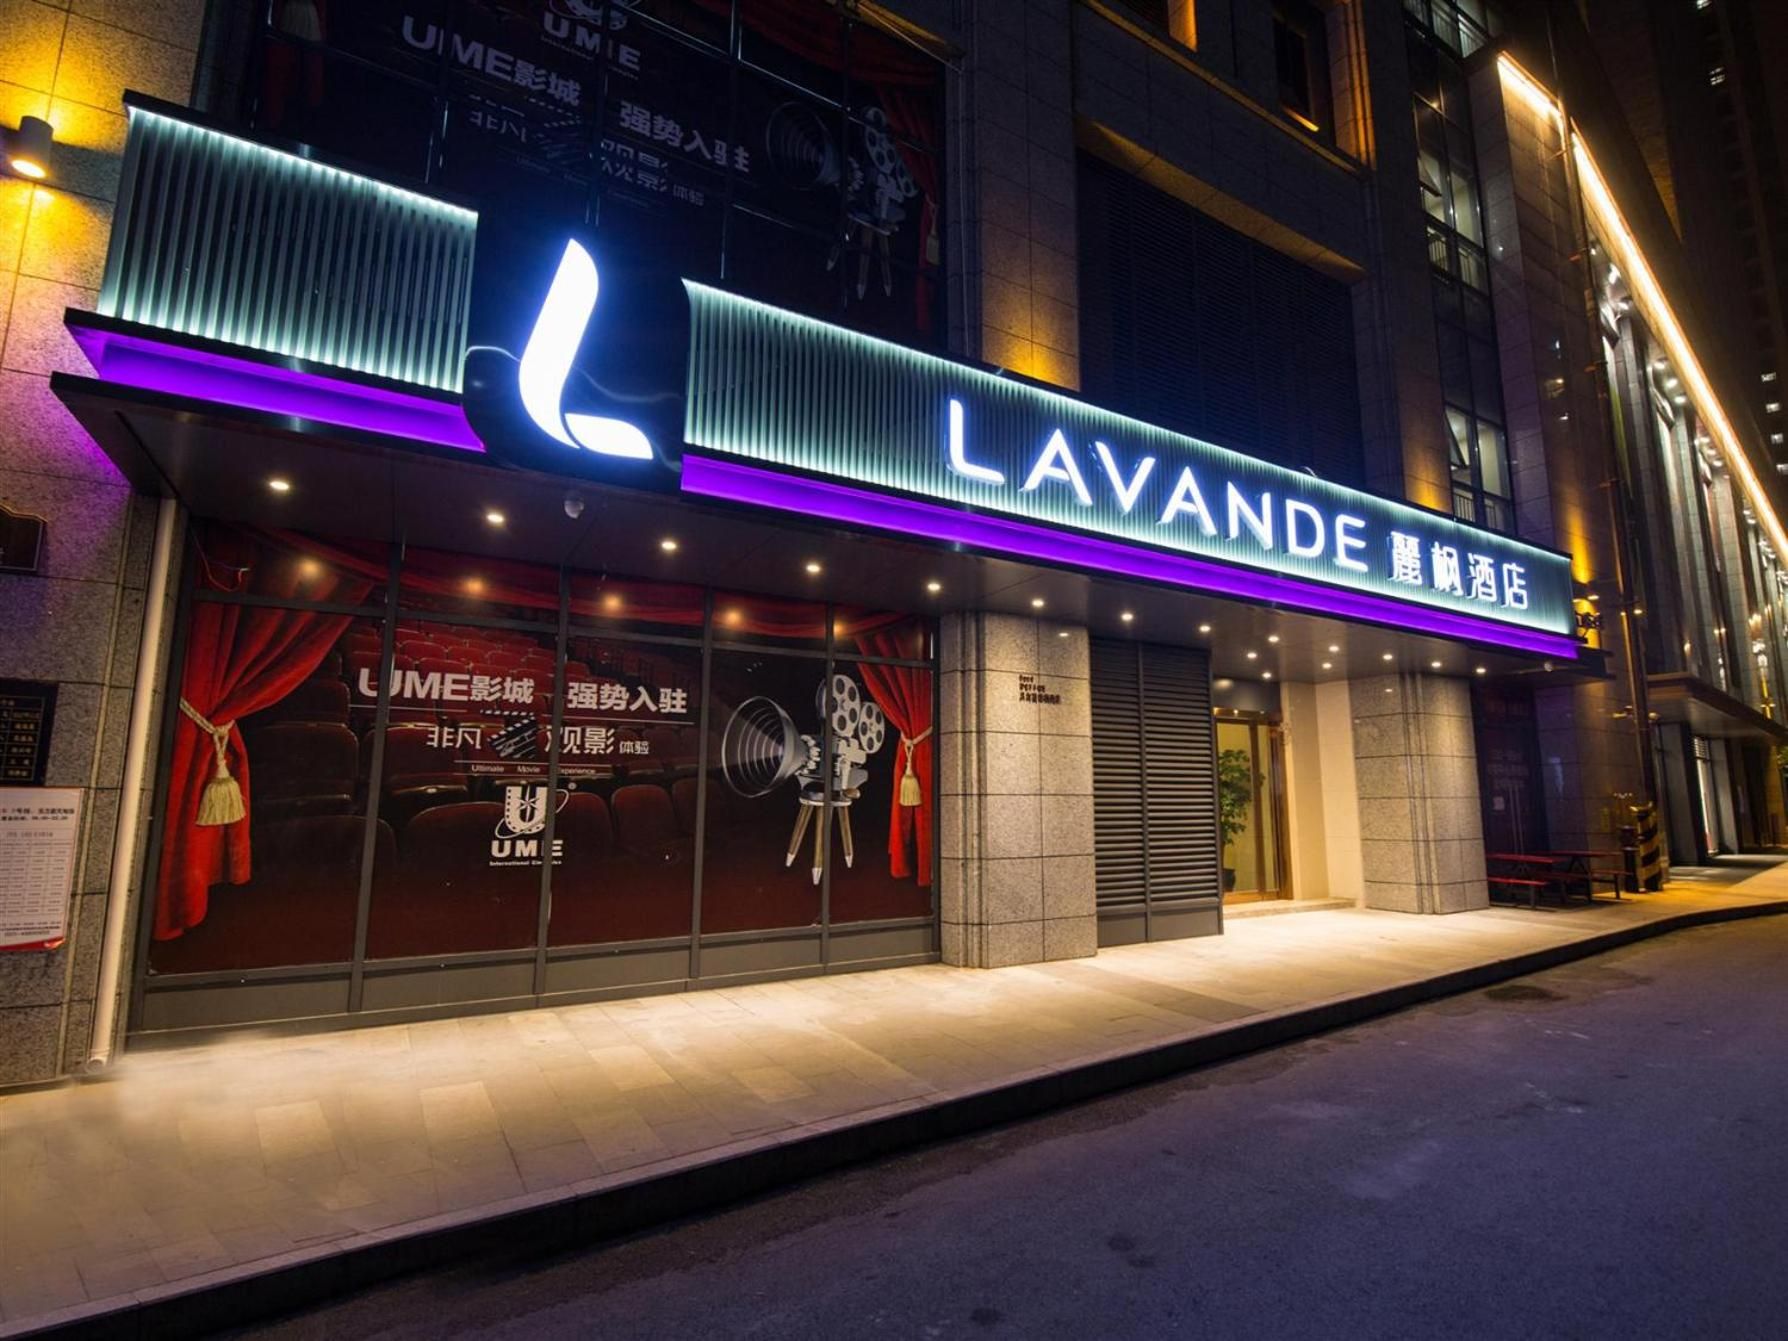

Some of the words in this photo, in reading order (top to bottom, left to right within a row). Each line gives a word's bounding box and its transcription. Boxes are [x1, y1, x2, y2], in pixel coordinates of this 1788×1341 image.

[543, 11, 641, 72] UME
[402, 15, 581, 107] UME影城
[620, 101, 750, 173] 强势入驻
[948, 398, 1369, 573] LAVANDE
[1387, 530, 1529, 610] 麗枫酒店
[357, 667, 536, 705] UME影城
[567, 681, 688, 715] 强势入驻
[425, 726, 482, 751] 非凡
[544, 725, 616, 756] 观影
[618, 740, 650, 756] 体验
[490, 839, 564, 858] UME
